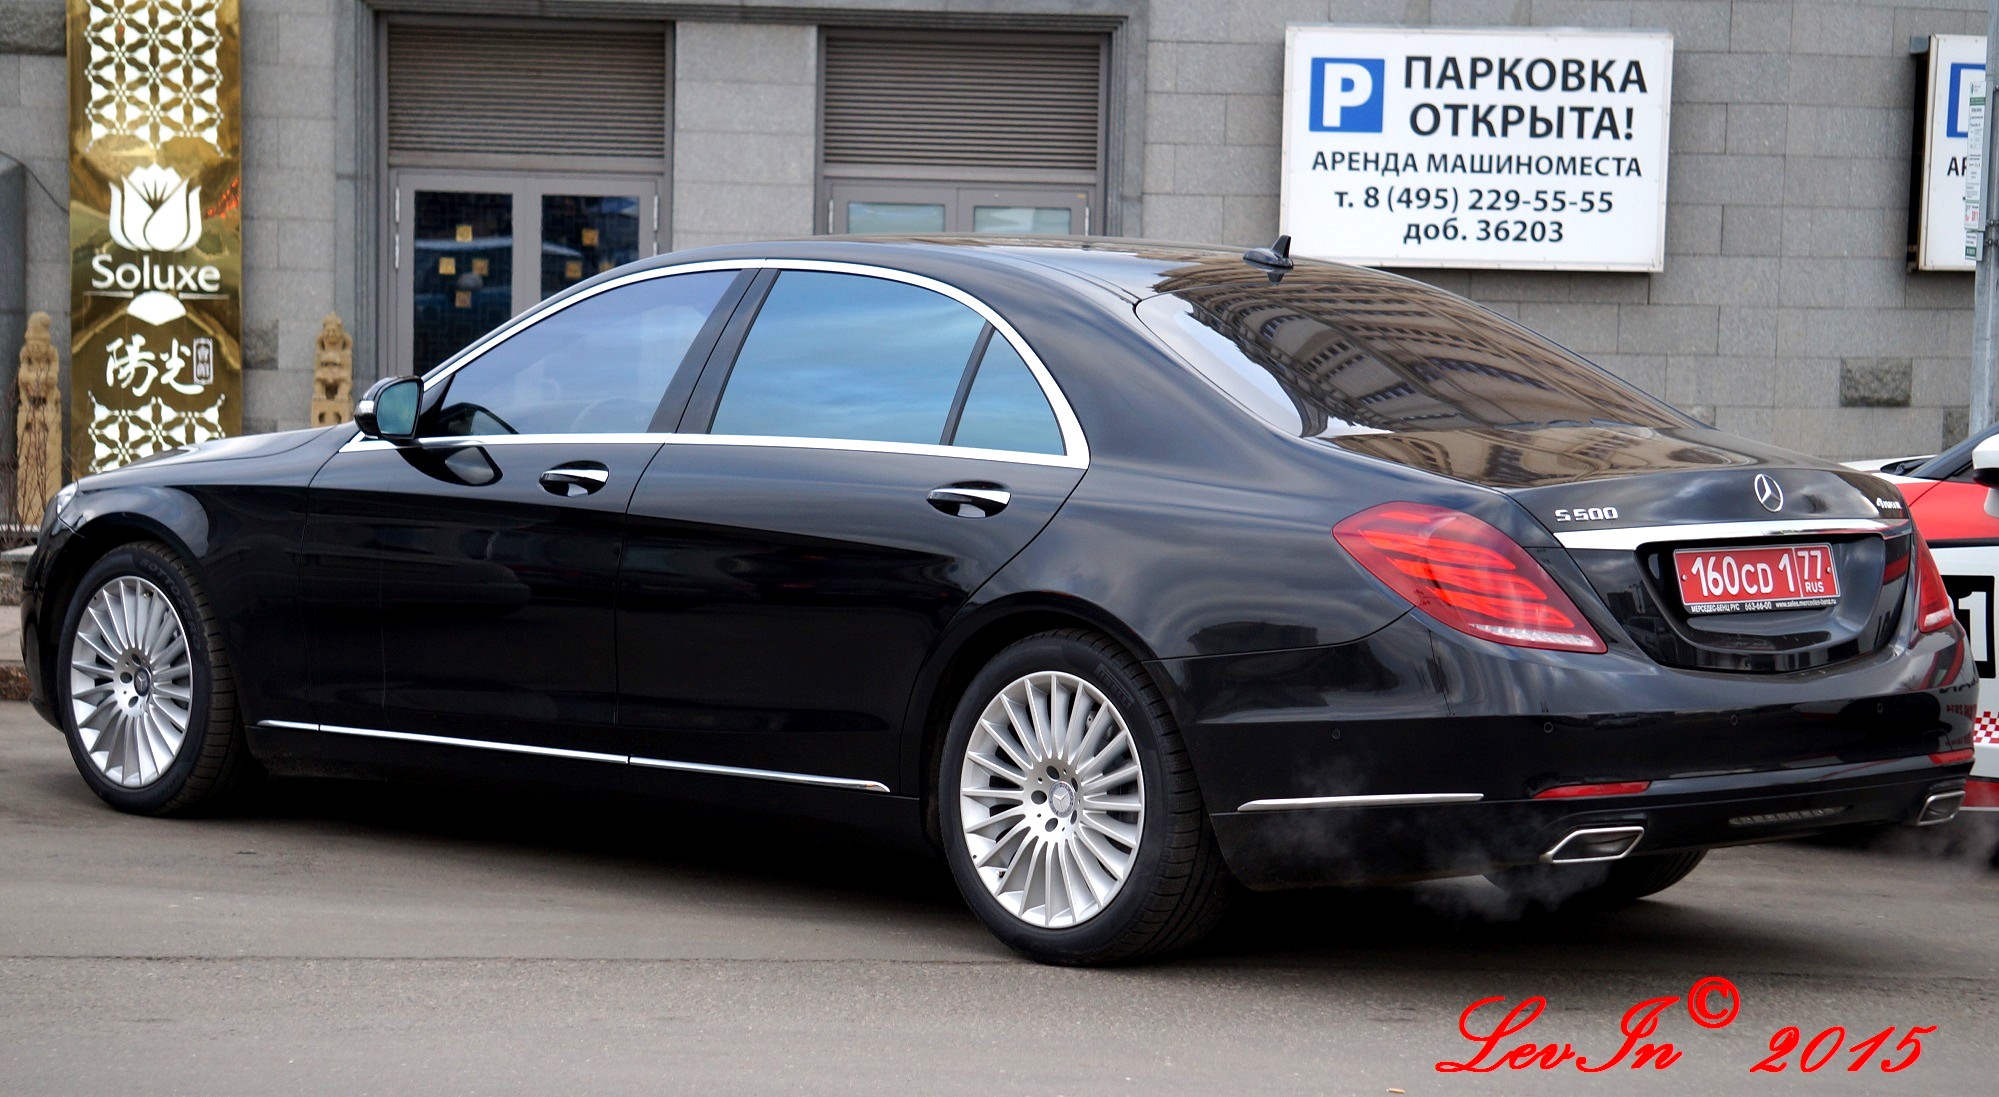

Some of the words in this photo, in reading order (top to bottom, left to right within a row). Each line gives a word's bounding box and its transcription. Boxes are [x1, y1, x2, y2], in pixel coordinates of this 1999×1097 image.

[1404, 55, 1648, 94] ПАРКОВКА
[1409, 102, 1634, 141] ОТКРЫТА!
[1312, 151, 1418, 177] АРЕНДА
[1427, 153, 1642, 178] МАШИНОМЕСТА
[1335, 191, 1354, 208] т.
[1364, 187, 1380, 208] 8
[1387, 186, 1459, 213] (495)
[1468, 189, 1613, 213] 229-55-55
[1403, 217, 1467, 245] доб.
[1476, 219, 1564, 243] 36203
[91, 253, 221, 292] Soluxe
[1554, 509, 1571, 522] S
[1573, 506, 1619, 521] 500
[1797, 550, 1822, 580] 77
[1805, 581, 1825, 593] RUS
[1948, 590, 1988, 662] 1
